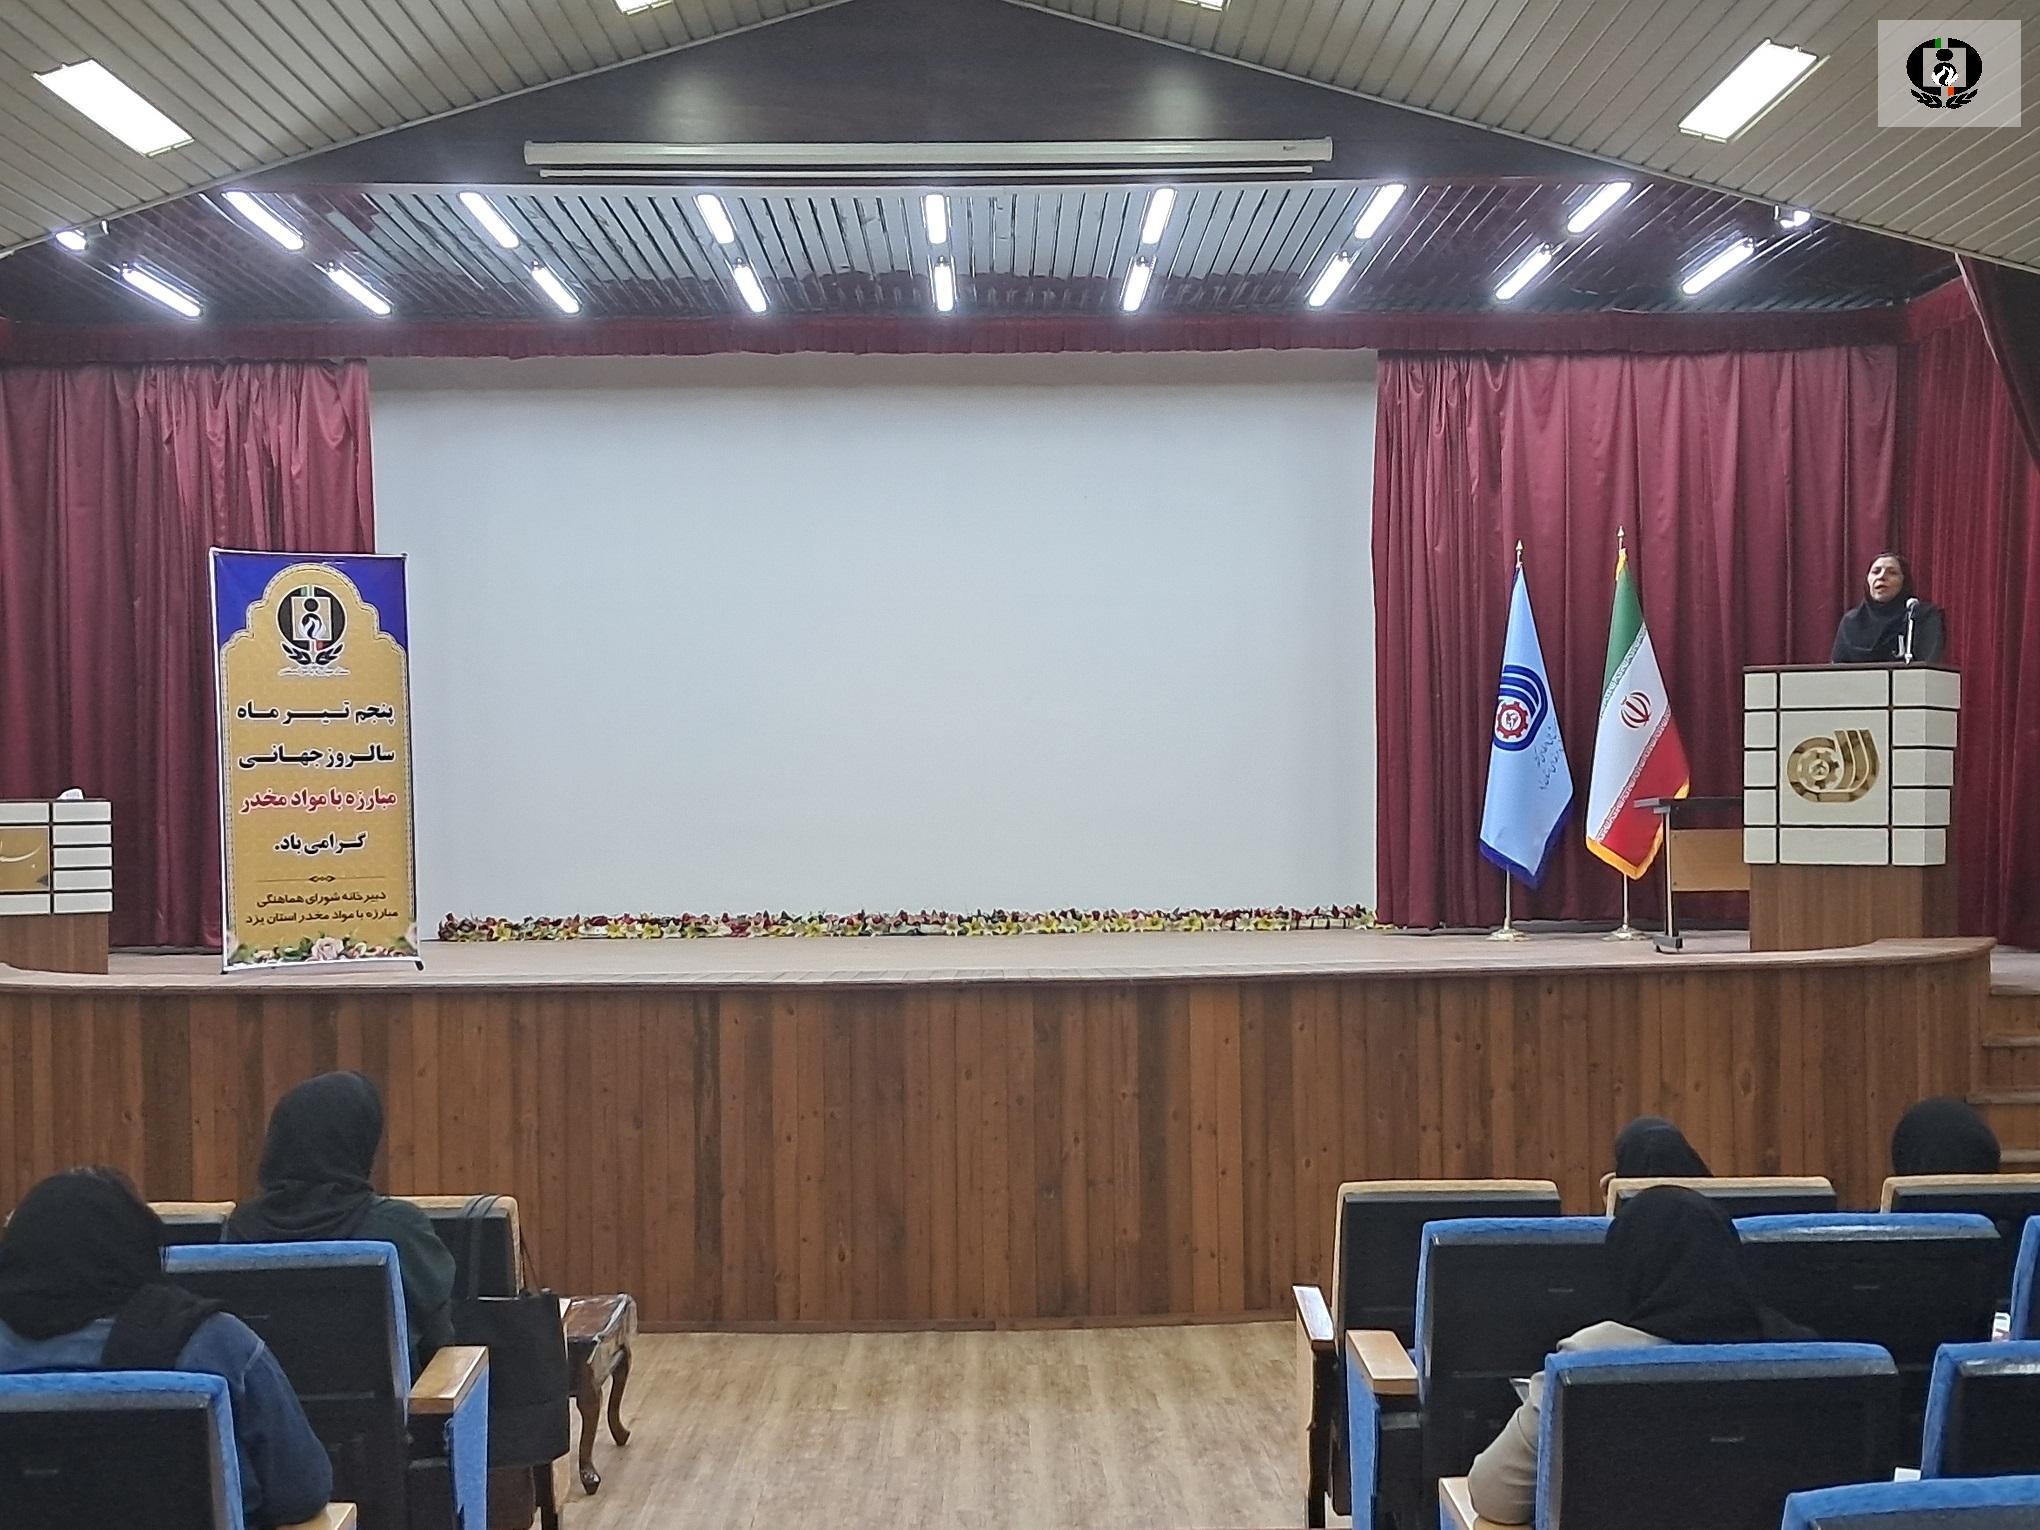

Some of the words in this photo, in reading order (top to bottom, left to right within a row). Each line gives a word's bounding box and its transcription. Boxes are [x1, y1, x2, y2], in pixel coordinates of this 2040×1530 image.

[238, 701, 279, 719] ماه
[283, 701, 349, 724] تیر
[355, 704, 394, 725] پنجم
[239, 744, 323, 768] جهانی
[326, 744, 395, 768] سالروز
[241, 789, 287, 812] مخدر
[291, 789, 326, 811] مواد
[330, 788, 342, 810] با
[346, 788, 396, 810] مبارزه
[304, 832, 366, 854] گرامی
[257, 894, 304, 908] هماهنگی
[306, 892, 341, 905] شورای
[246, 916, 265, 926] یزد
[267, 912, 297, 924] استان
[299, 912, 329, 924] مخدر
[332, 909, 354, 922] مواد
[357, 908, 365, 920] با
[366, 908, 398, 919] مبارزه
